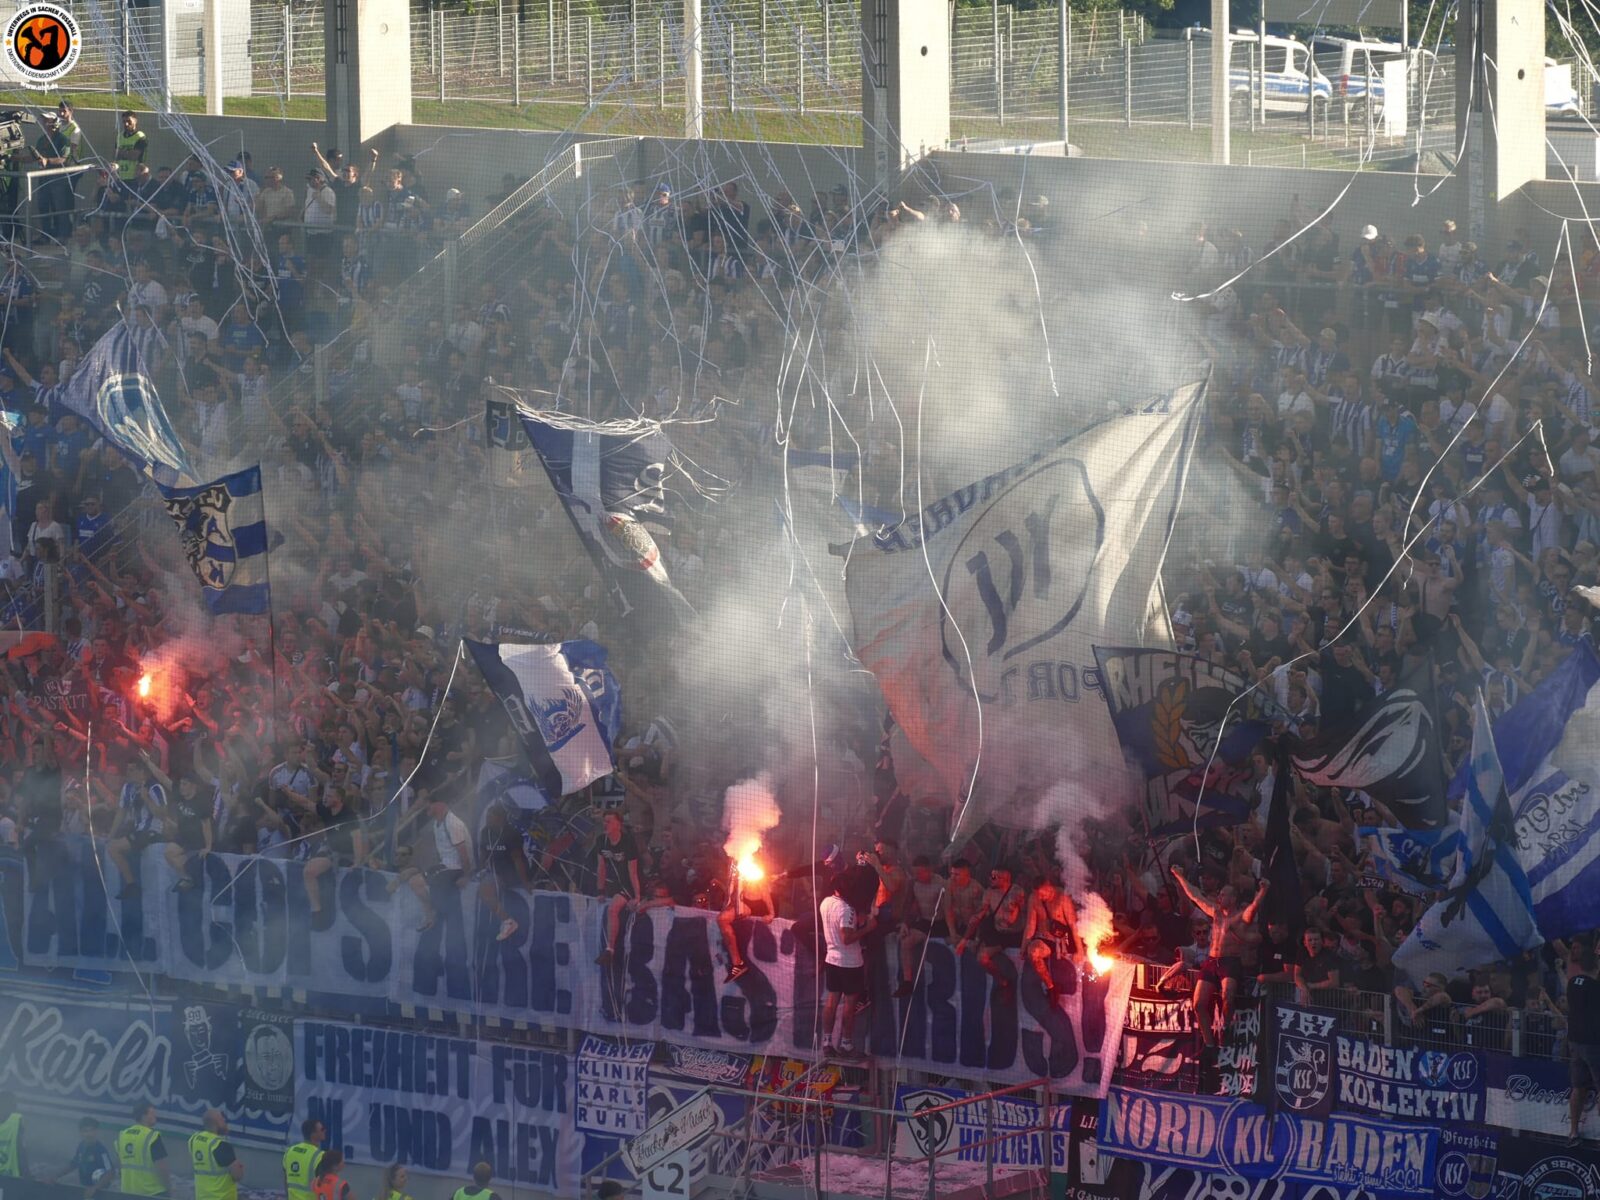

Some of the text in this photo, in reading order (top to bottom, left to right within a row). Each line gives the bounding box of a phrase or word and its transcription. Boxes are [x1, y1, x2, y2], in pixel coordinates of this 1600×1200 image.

[412, 877, 572, 1014] ARE
[583, 1038, 654, 1058] NERVEN
[1336, 1035, 1418, 1081] BADEN
[304, 1022, 568, 1113] FREIHEIT FÜR
[578, 1060, 646, 1081] KLINIK
[1293, 1069, 1312, 1089] KSC
[1453, 1059, 1472, 1082] KSC
[578, 1084, 645, 1106] KARLS
[1340, 1073, 1479, 1121] KOLLEKTIV
[370, 1102, 452, 1170] UND
[467, 1116, 560, 1189] ALEX
[1105, 1092, 1216, 1158] NORD
[1234, 1114, 1279, 1165] KSC
[1298, 1119, 1430, 1185] BADEN
[648, 1162, 685, 1195] C2
[1444, 1162, 1465, 1185] KSC
[1551, 1160, 1595, 1196] SEKTION
